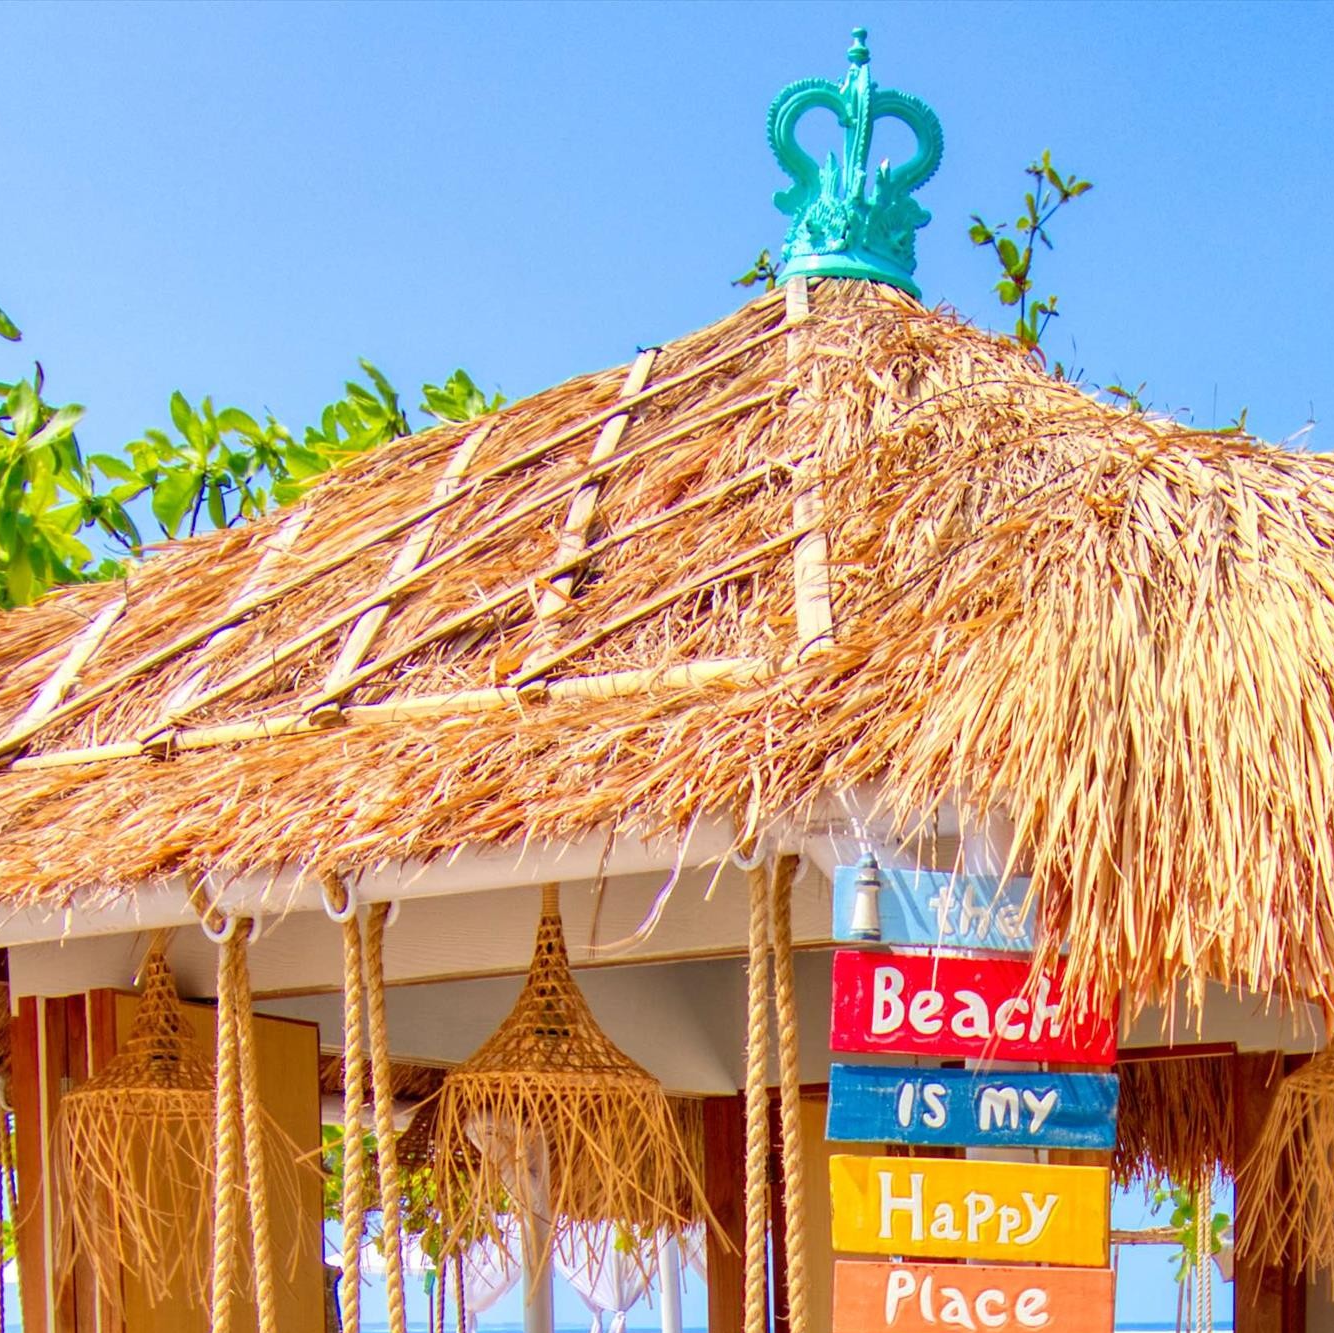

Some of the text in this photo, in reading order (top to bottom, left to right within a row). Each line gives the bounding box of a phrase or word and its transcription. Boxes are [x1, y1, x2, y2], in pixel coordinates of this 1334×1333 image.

[929, 886, 1026, 940] the
[871, 966, 1062, 1043] Beach
[877, 1171, 1059, 1245] Happy
[885, 1269, 1050, 1331] Place
